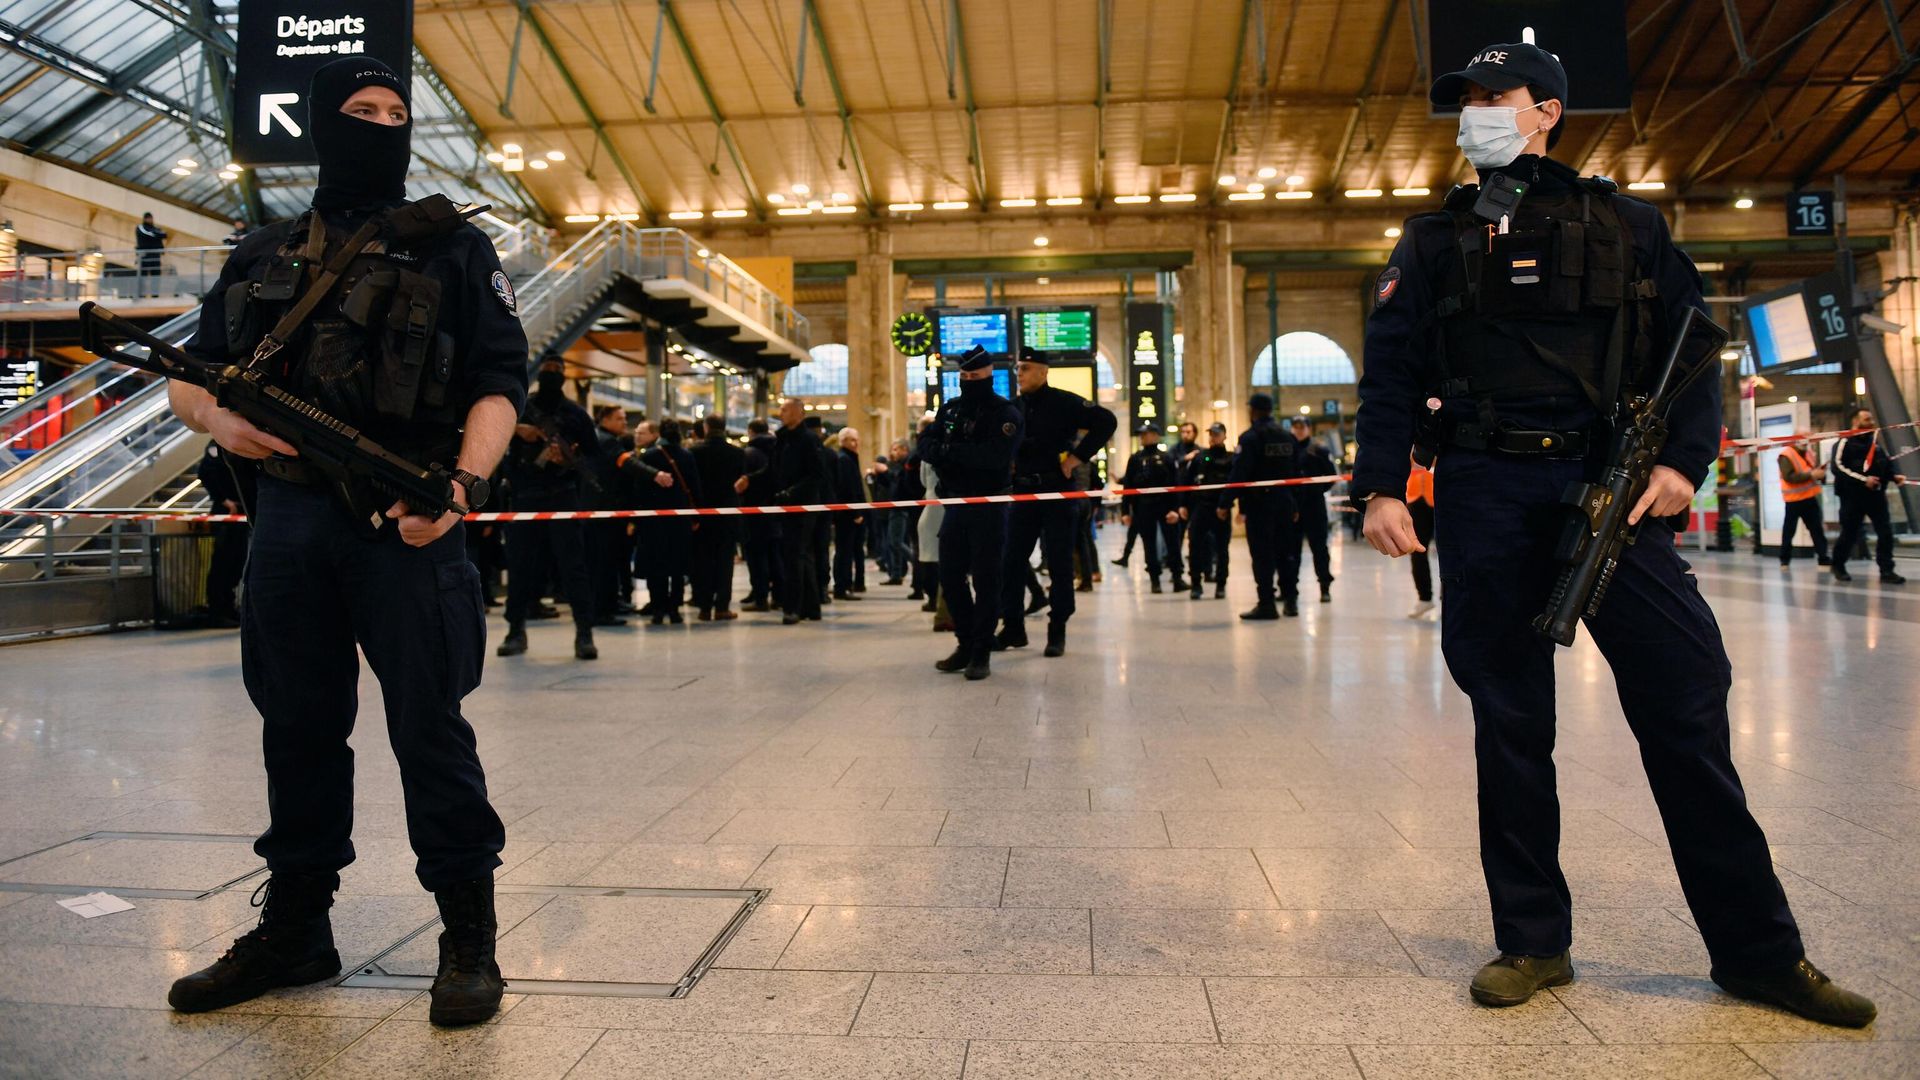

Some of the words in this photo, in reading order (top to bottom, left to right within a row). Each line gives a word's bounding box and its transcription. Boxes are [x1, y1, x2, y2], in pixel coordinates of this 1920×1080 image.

[277, 15, 365, 41] Départs
[276, 44, 331, 58] Departures
[355, 70, 399, 83] POLICE
[1796, 206, 1826, 226] 16
[1821, 306, 1845, 334] 16
